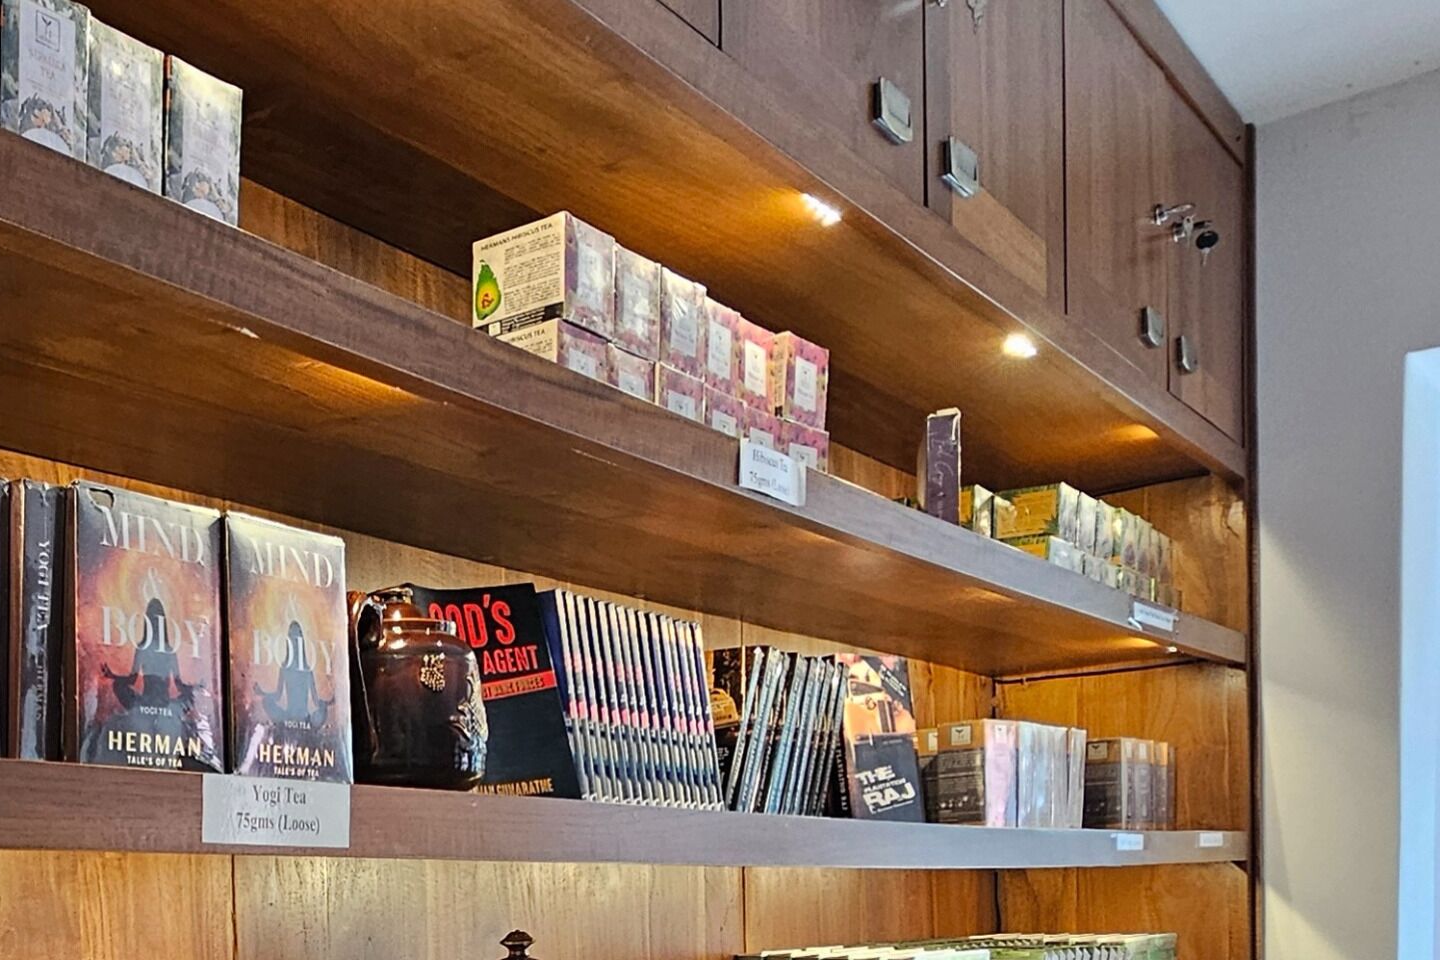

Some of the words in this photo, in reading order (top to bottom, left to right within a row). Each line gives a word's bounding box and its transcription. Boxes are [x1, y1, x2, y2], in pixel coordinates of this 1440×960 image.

[541, 223, 553, 232] TEA
[99, 505, 206, 568] MIND
[38, 540, 50, 586] YOGI
[248, 537, 333, 588] MIND
[37, 593, 50, 631] TEA
[99, 606, 209, 659] BODY
[251, 629, 336, 676] BODY
[482, 645, 538, 675] AGENT
[108, 730, 201, 757] HERMAN
[259, 743, 335, 768] HERMAN
[155, 757, 166, 766] OF
[168, 758, 182, 768] TEA
[855, 765, 895, 785] THE
[253, 785, 280, 806] Yogi
[284, 788, 306, 804] Tea
[864, 782, 916, 808] RAJ
[236, 812, 274, 831] 75gms
[278, 813, 320, 834] (Loose)
